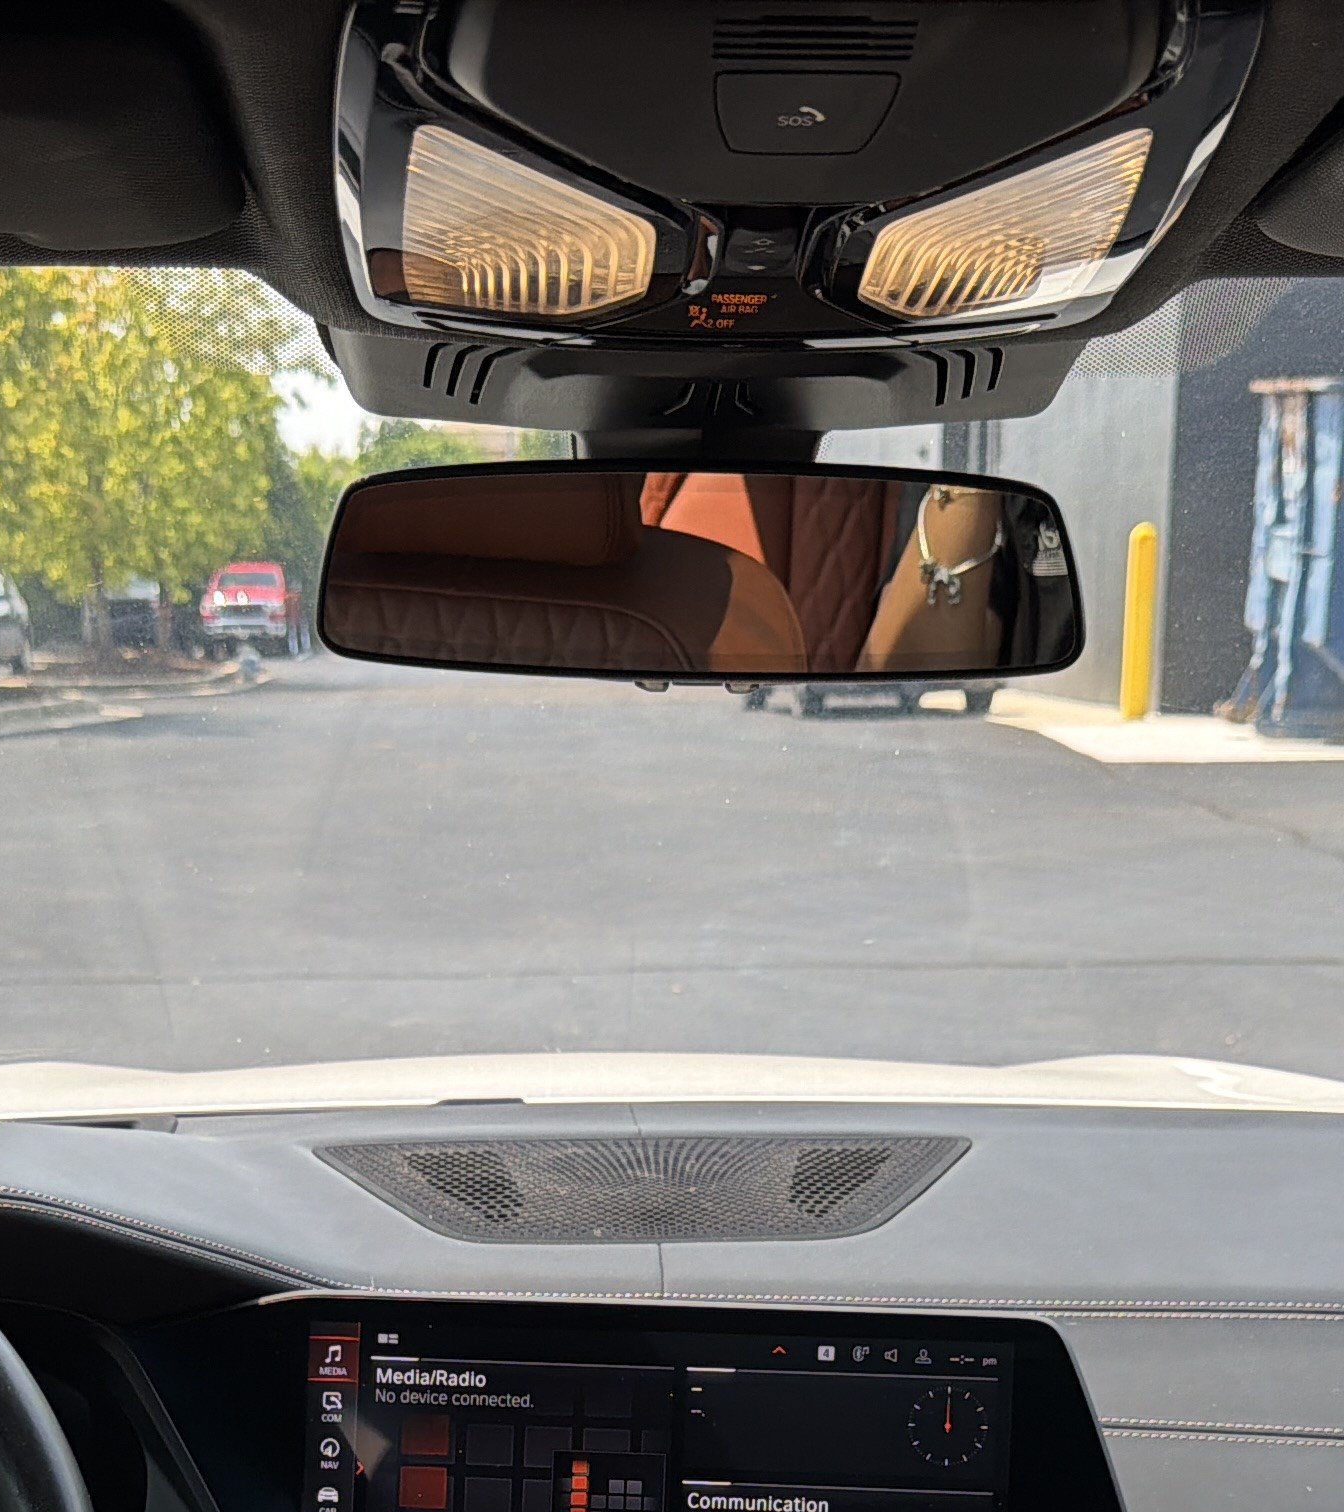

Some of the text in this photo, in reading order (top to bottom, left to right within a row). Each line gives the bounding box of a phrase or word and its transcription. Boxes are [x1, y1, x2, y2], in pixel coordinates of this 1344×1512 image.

[777, 116, 813, 127] SOS
[711, 293, 767, 304] PASSENGER
[720, 304, 736, 314] AIR
[716, 319, 735, 329] OFF
[982, 1357, 998, 1367] pm
[318, 1366, 348, 1377] MEDIA
[376, 1367, 487, 1388] Media/Radio
[375, 1388, 534, 1409] No device connected.
[321, 1413, 342, 1423] COM
[320, 1460, 339, 1470] NAV
